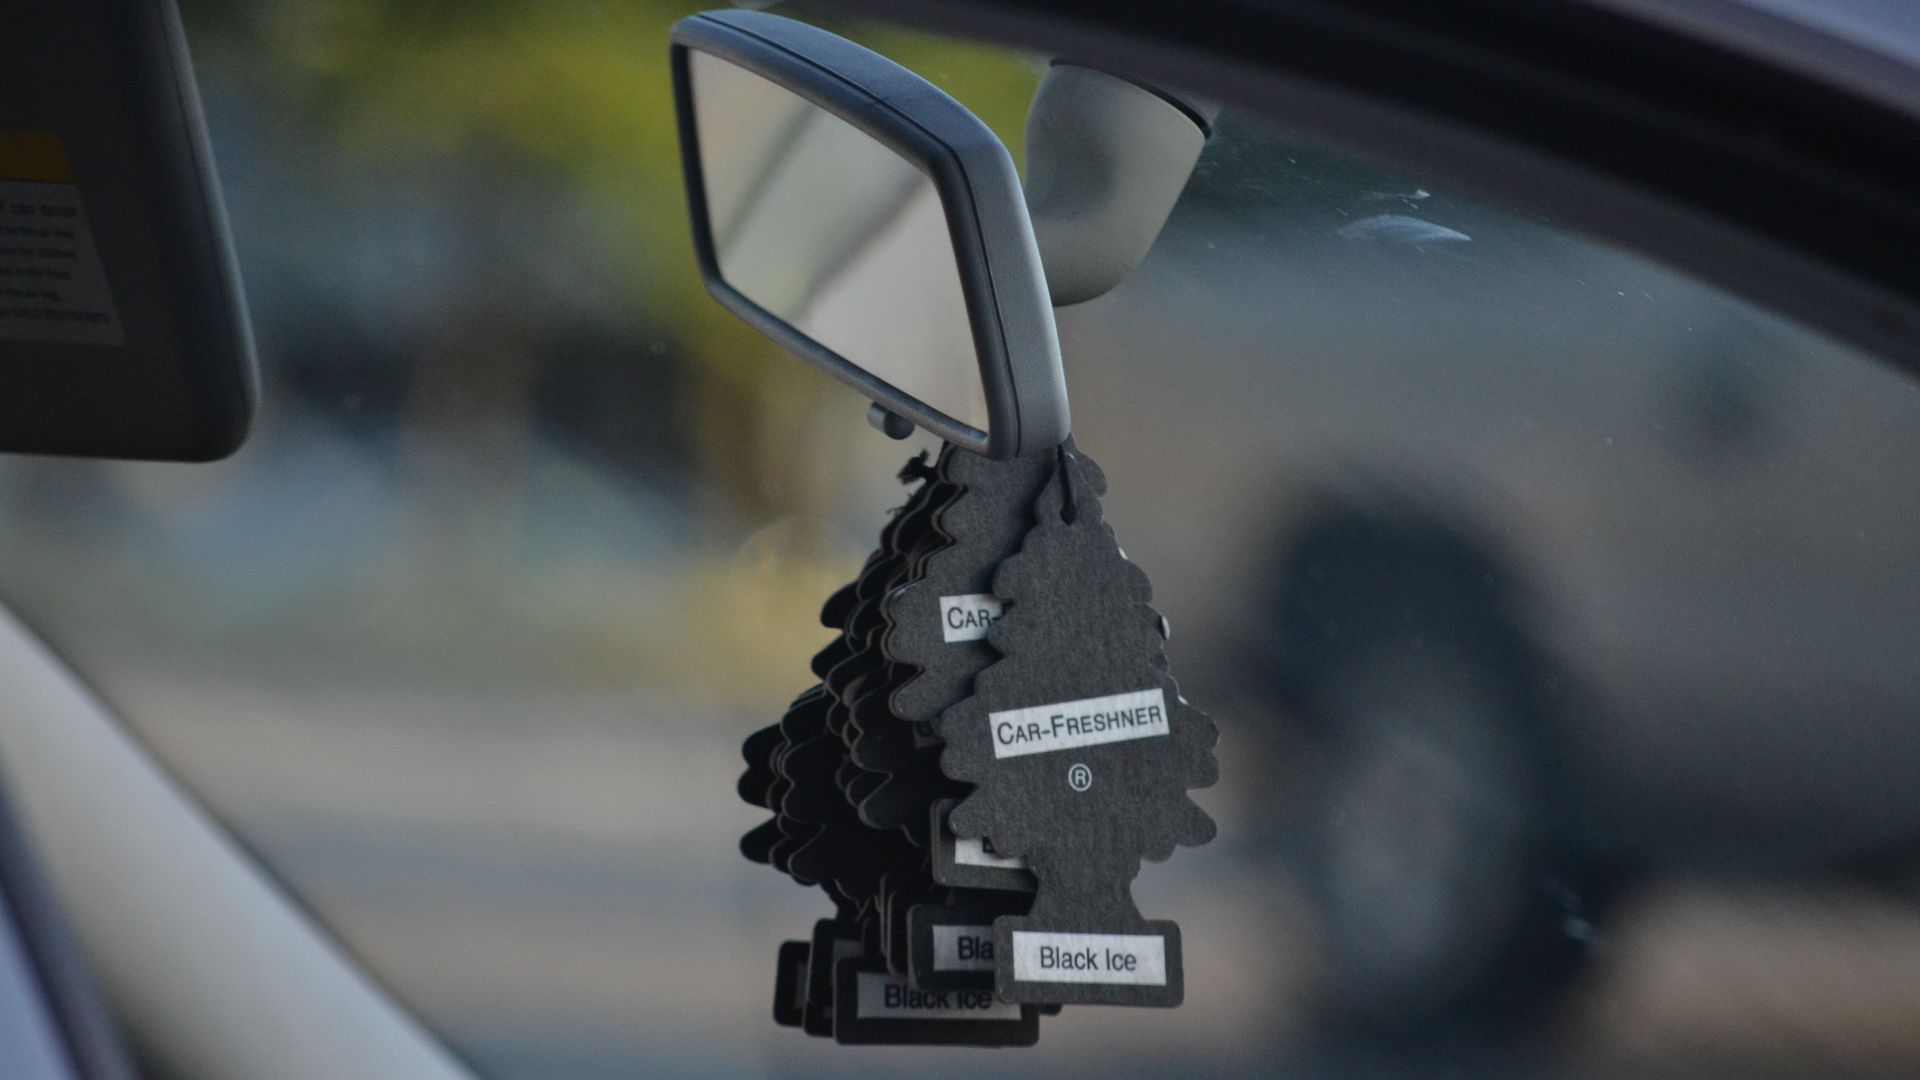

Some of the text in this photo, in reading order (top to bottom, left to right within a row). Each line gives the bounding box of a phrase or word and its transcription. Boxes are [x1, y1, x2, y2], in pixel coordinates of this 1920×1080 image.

[997, 705, 1162, 745] CAR-FRESHNER
[957, 936, 995, 961] Bla
[1039, 946, 1137, 971] Black Ice
[884, 984, 950, 1009] Black
